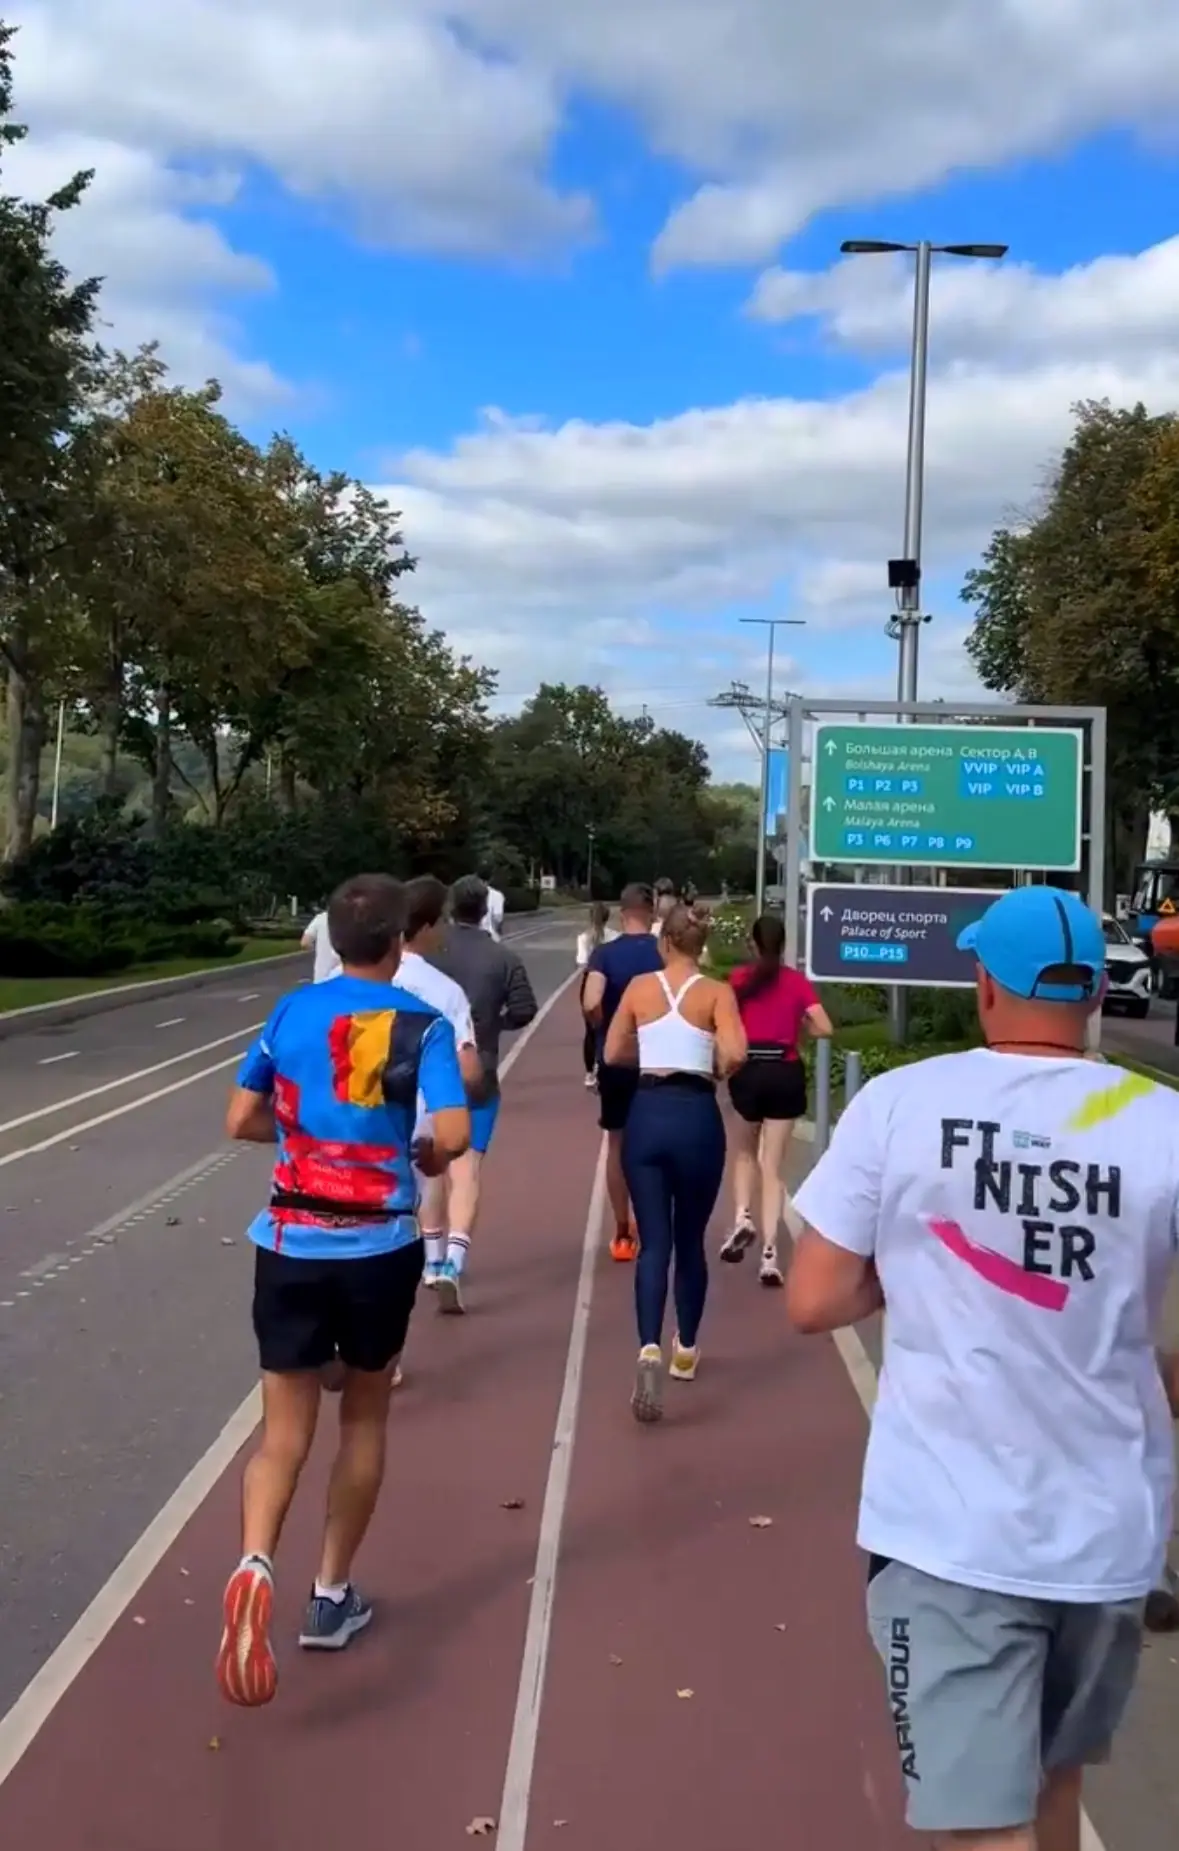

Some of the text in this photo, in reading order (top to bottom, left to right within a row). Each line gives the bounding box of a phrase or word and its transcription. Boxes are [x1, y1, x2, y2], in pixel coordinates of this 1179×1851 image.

[845, 742, 953, 759] Большая арена
[960, 746, 1011, 761] Сектор
[845, 759, 931, 773] Bolshaya Arena
[963, 762, 1044, 776] VVIP VIP A
[848, 778, 864, 791] P1
[875, 779, 892, 792] P2
[967, 782, 1044, 796] VIP VIP B
[844, 799, 936, 815] Малая арена
[844, 816, 921, 830] Malaya Arena
[874, 834, 891, 847] P6
[901, 835, 918, 848] P7
[928, 836, 945, 849] P8
[956, 836, 973, 849] P9
[841, 908, 948, 926] Дворец спорта
[841, 925, 928, 940] Palace of Sport
[941, 1118, 1001, 1169] FI
[974, 1158, 1121, 1218] NISH
[1022, 1220, 1096, 1281] ER
[890, 1617, 921, 1781] ARMOUR
